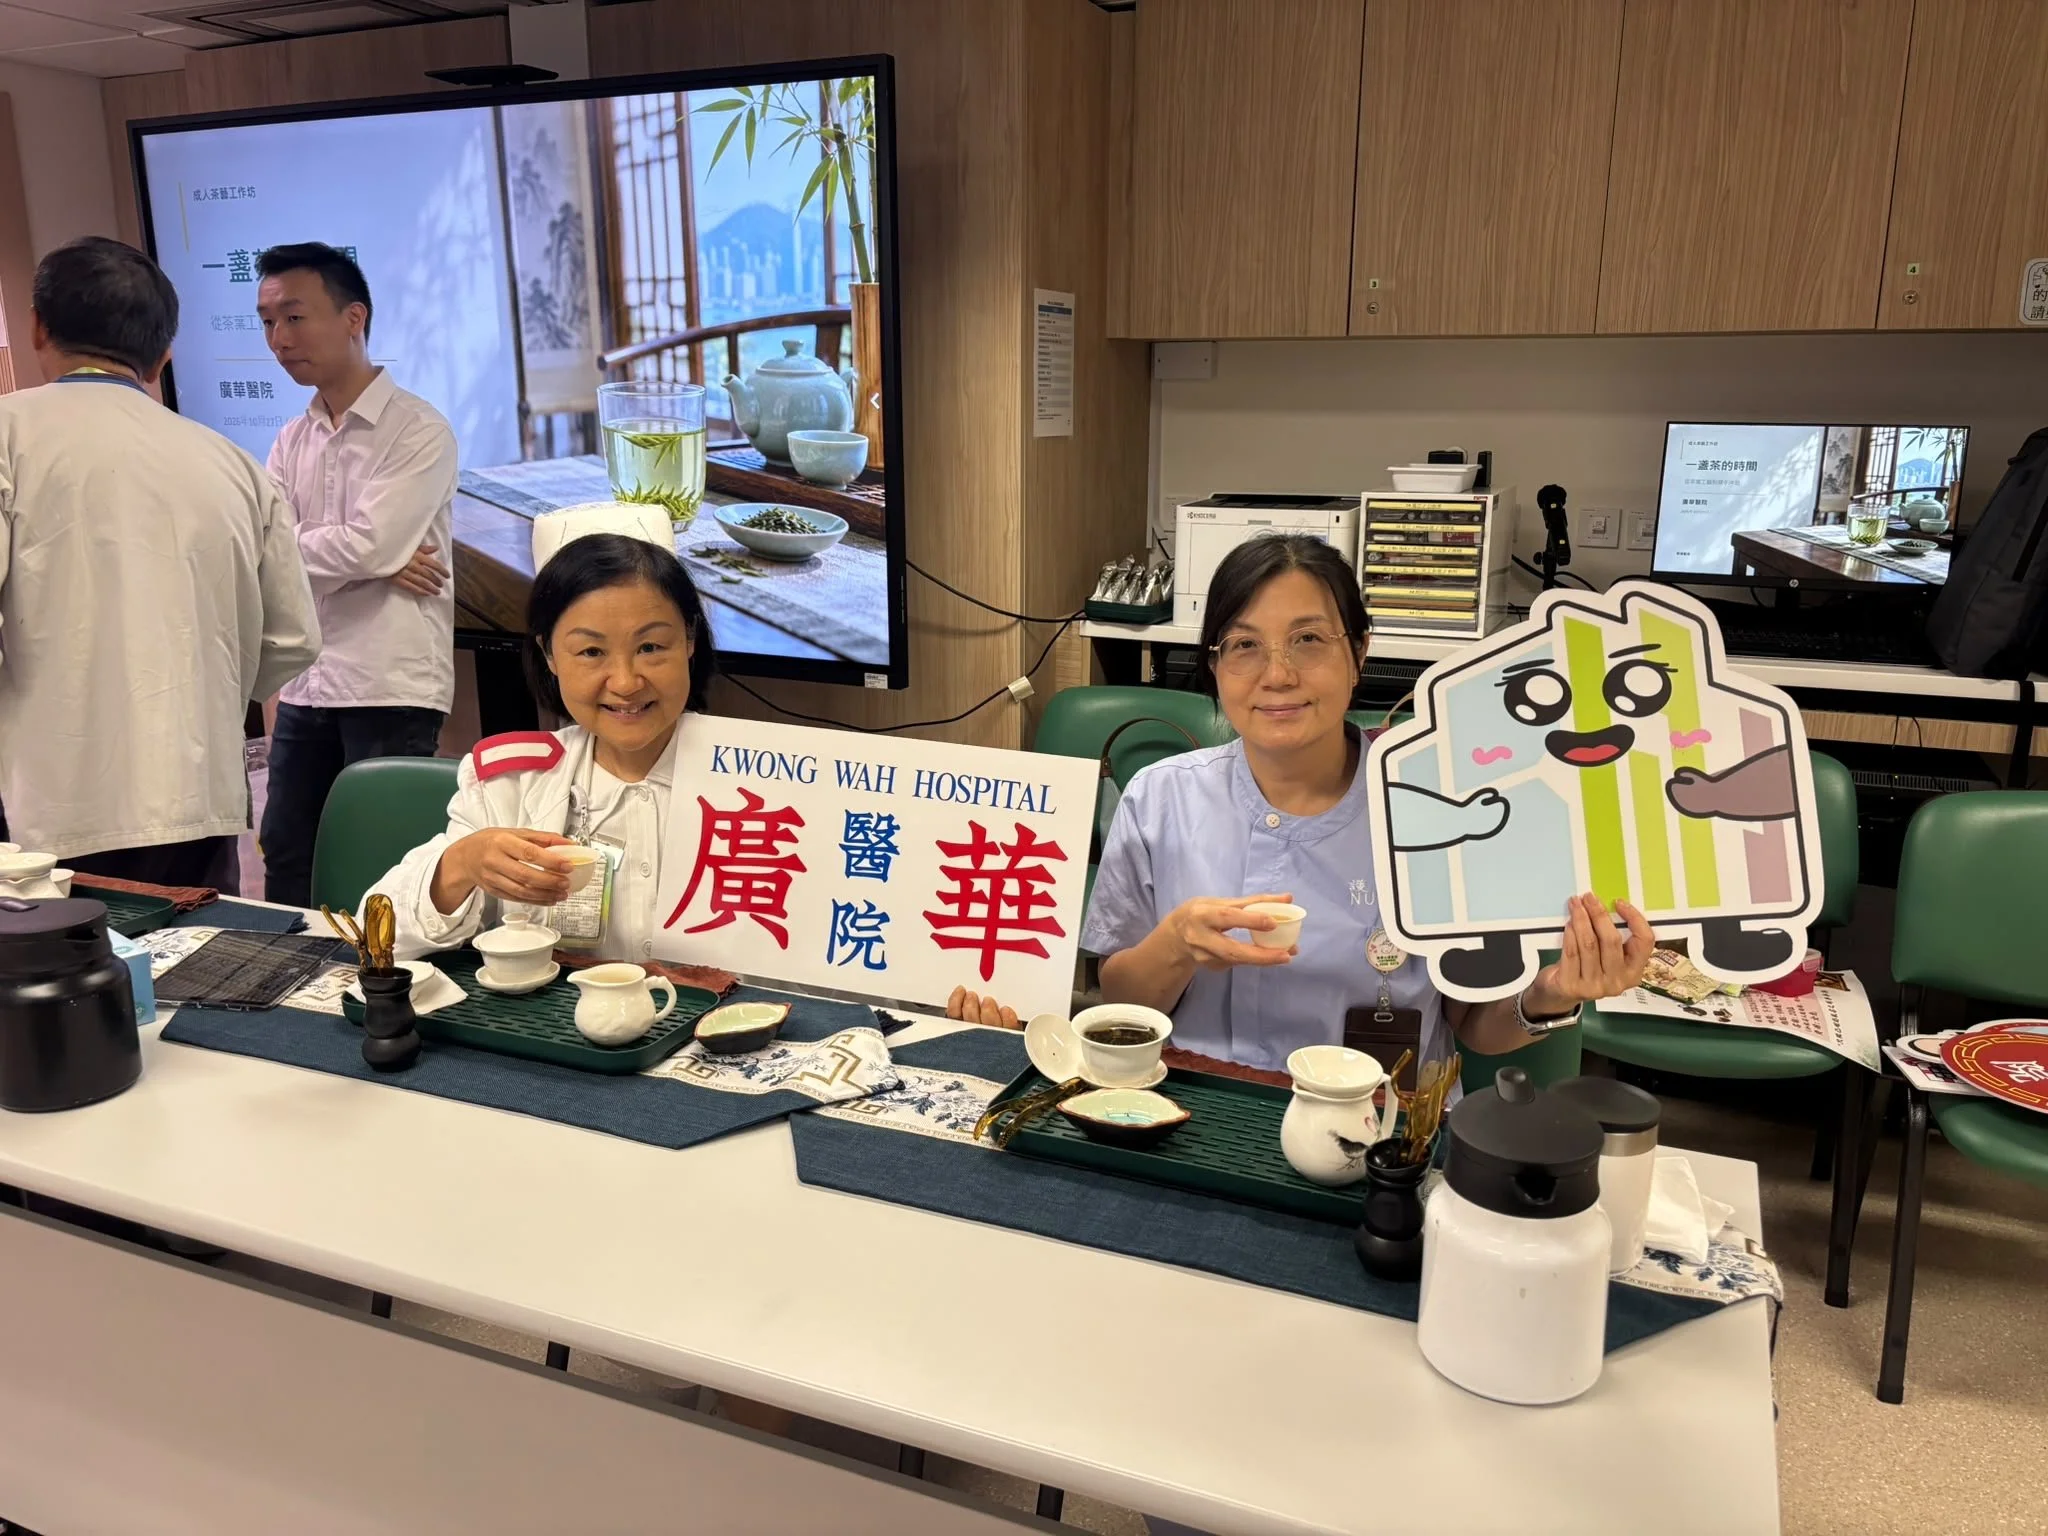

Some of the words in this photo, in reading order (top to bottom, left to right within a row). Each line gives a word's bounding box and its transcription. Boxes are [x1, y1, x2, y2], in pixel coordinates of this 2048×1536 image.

[219, 381, 274, 400] 廣華醫院
[710, 744, 818, 785] KWONG
[834, 759, 898, 795] WAH
[912, 769, 1058, 815] HOSPITAL
